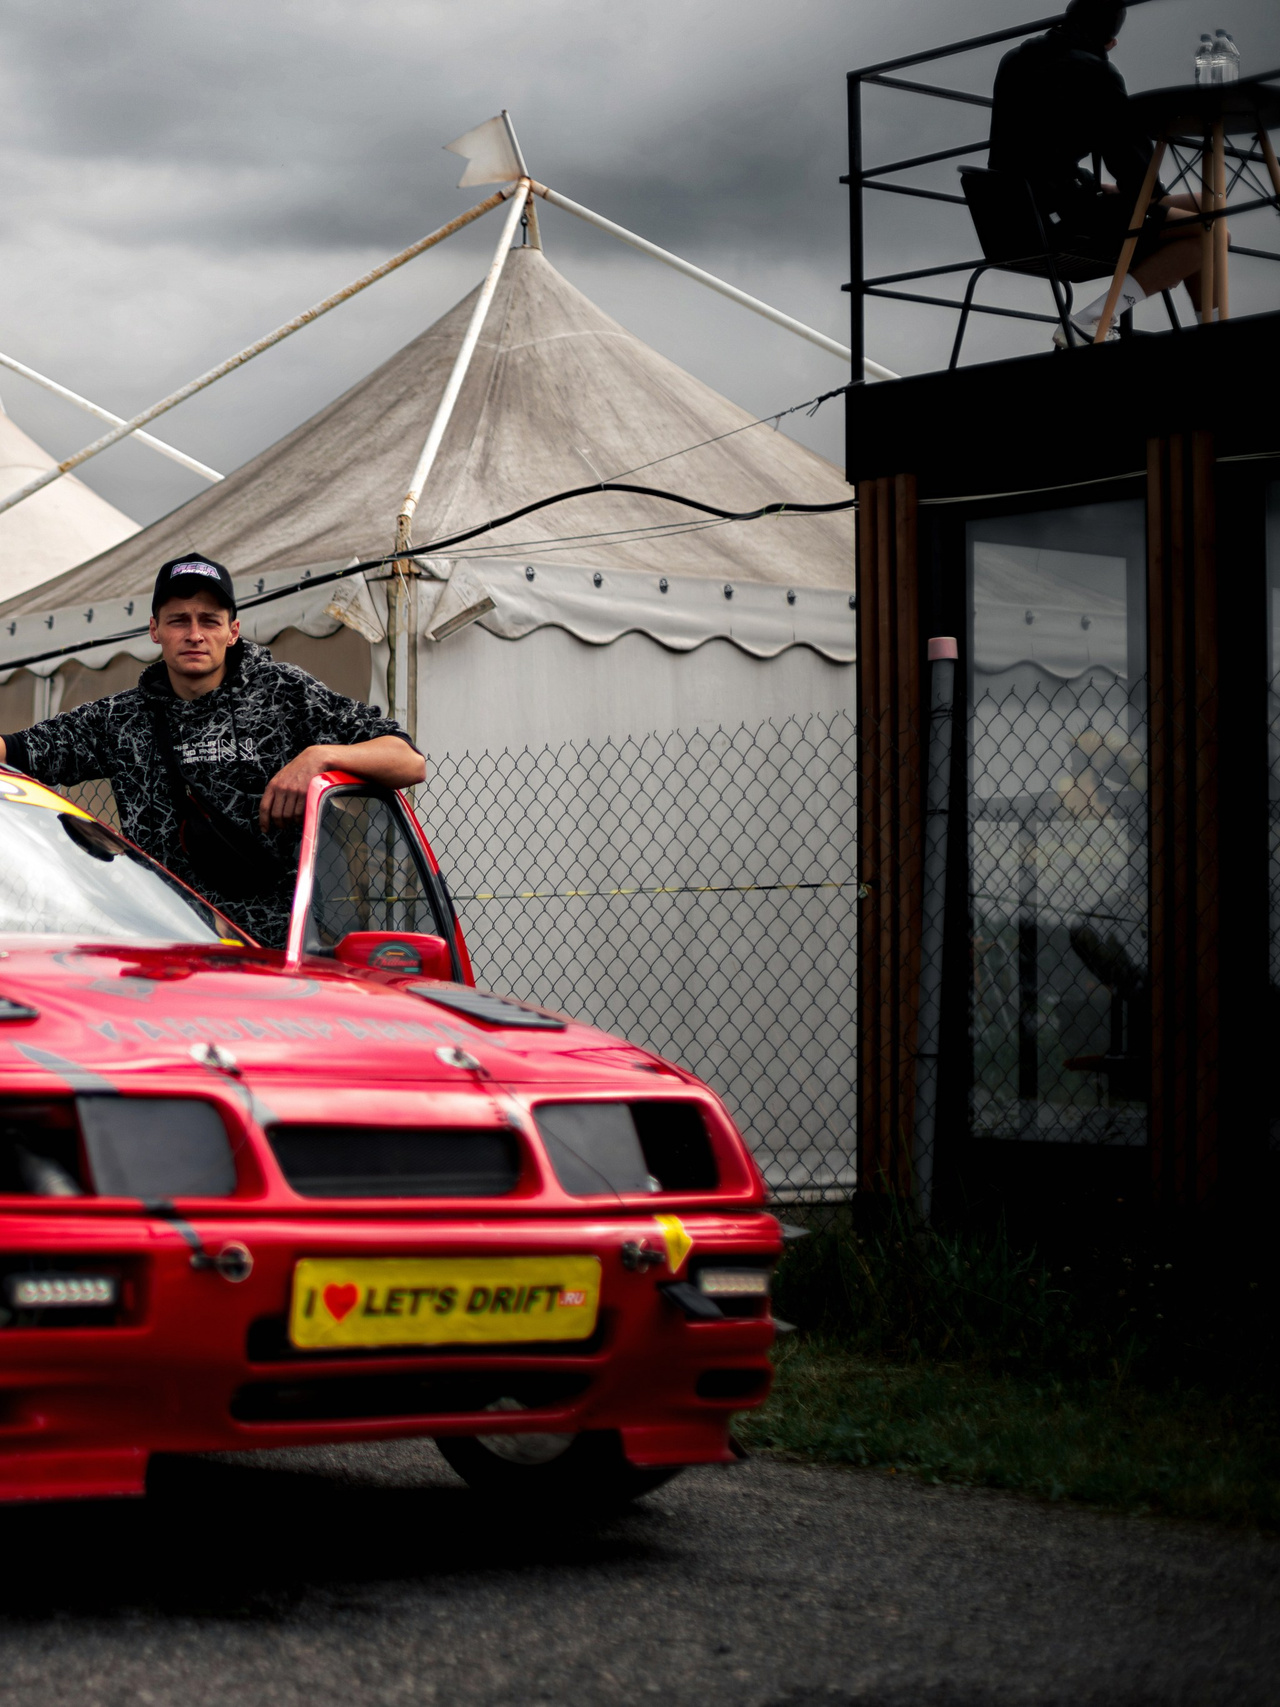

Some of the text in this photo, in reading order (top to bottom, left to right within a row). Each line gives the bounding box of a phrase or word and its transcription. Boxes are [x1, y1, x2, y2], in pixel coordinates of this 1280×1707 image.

[192, 740, 217, 749] YOUR
[303, 1289, 318, 1319] I
[361, 1287, 458, 1318] LET'S
